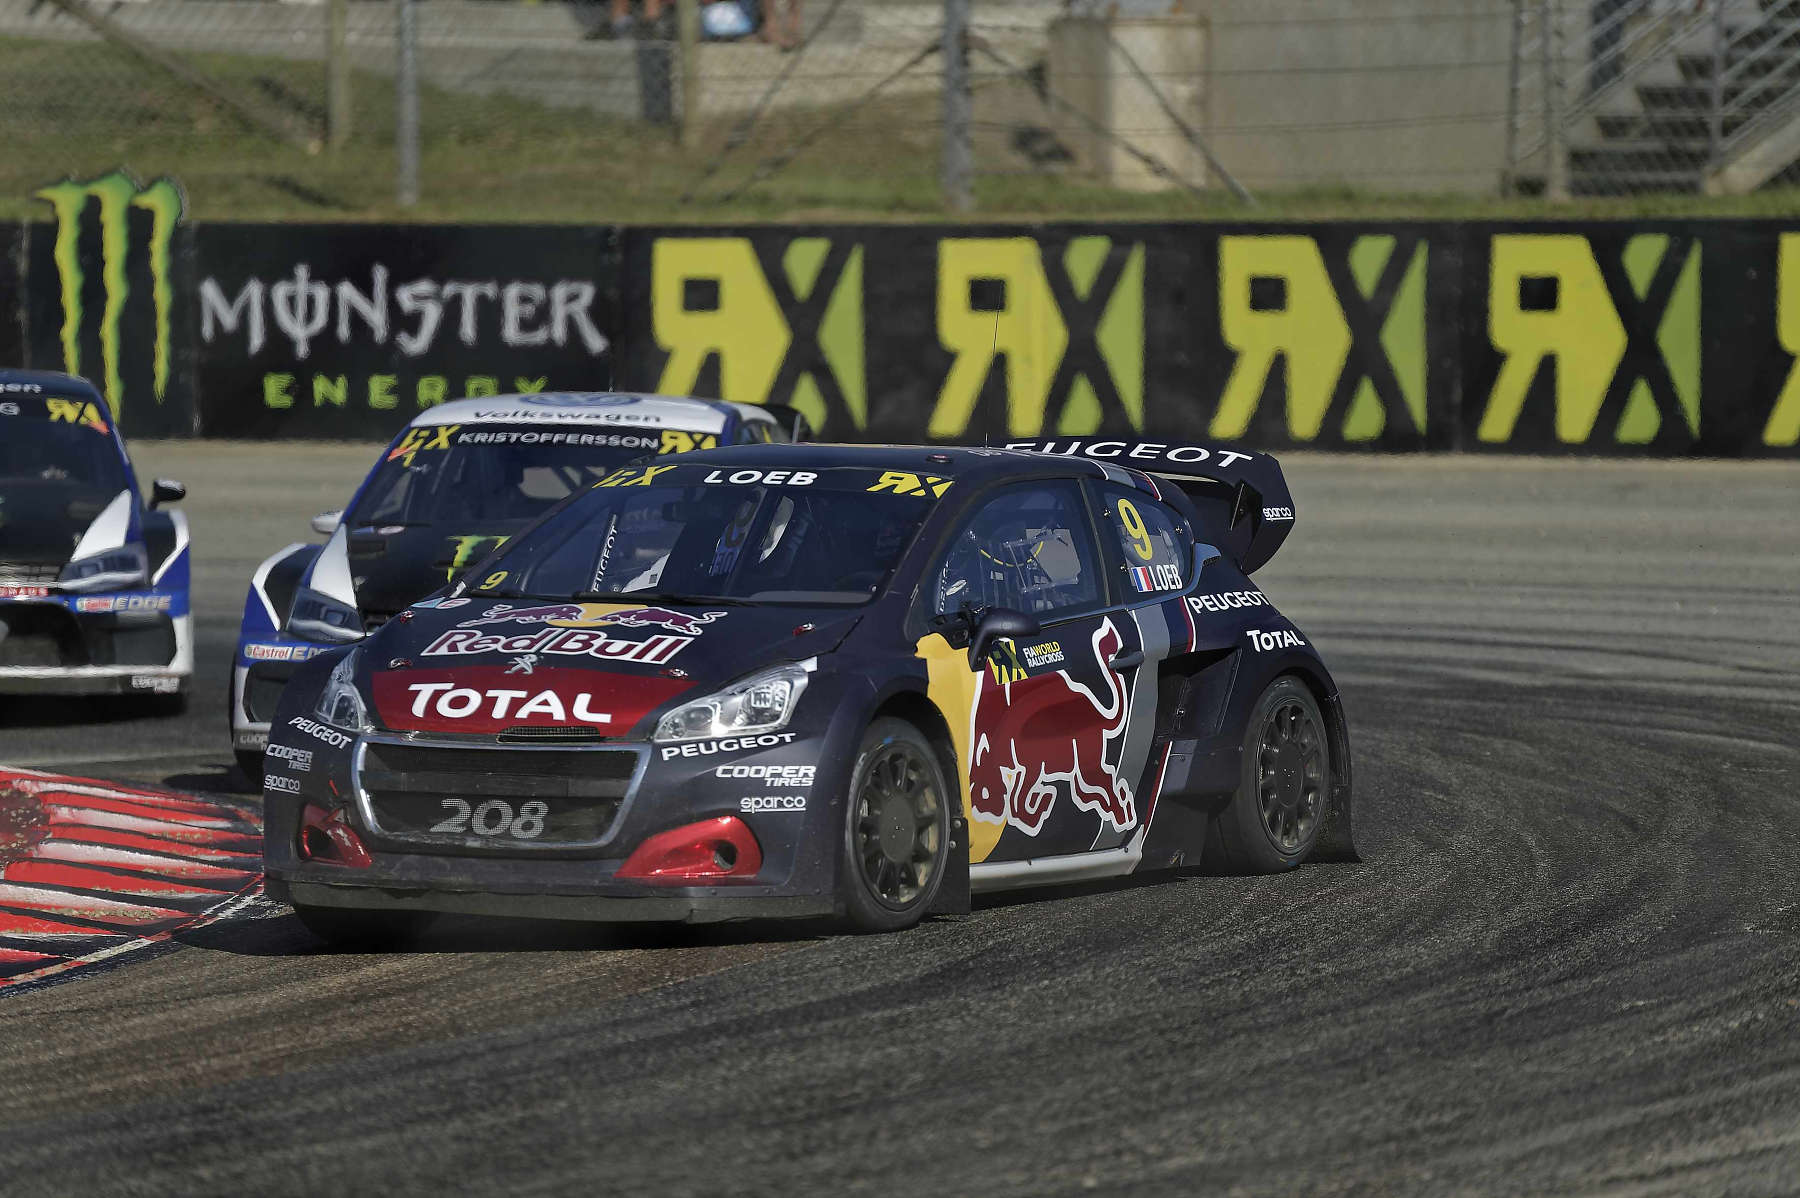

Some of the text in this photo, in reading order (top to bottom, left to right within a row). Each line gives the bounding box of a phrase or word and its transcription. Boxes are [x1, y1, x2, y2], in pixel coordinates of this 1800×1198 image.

[201, 262, 609, 359] MONSTER
[474, 409, 661, 423] Volkswagen
[457, 431, 660, 449] KRISTOFFERSSON
[704, 470, 818, 486] LOEB
[1117, 498, 1153, 560] 9
[479, 571, 508, 590] 9
[1149, 564, 1183, 591] LOEB
[1188, 591, 1270, 614] PEUGEOT
[252, 646, 290, 659] Castrol
[421, 629, 695, 665] Red Bull
[1027, 651, 1065, 668] RALLYCROSS
[288, 716, 352, 750] PEUGEOT
[266, 744, 313, 763] COOPER
[661, 732, 796, 761] PEUGEOT
[287, 760, 311, 772] TIRES
[715, 765, 816, 778] COOPER
[264, 775, 300, 794] sparco
[764, 777, 814, 787] TIRES
[740, 796, 806, 814] sparco
[430, 799, 550, 839] 208
